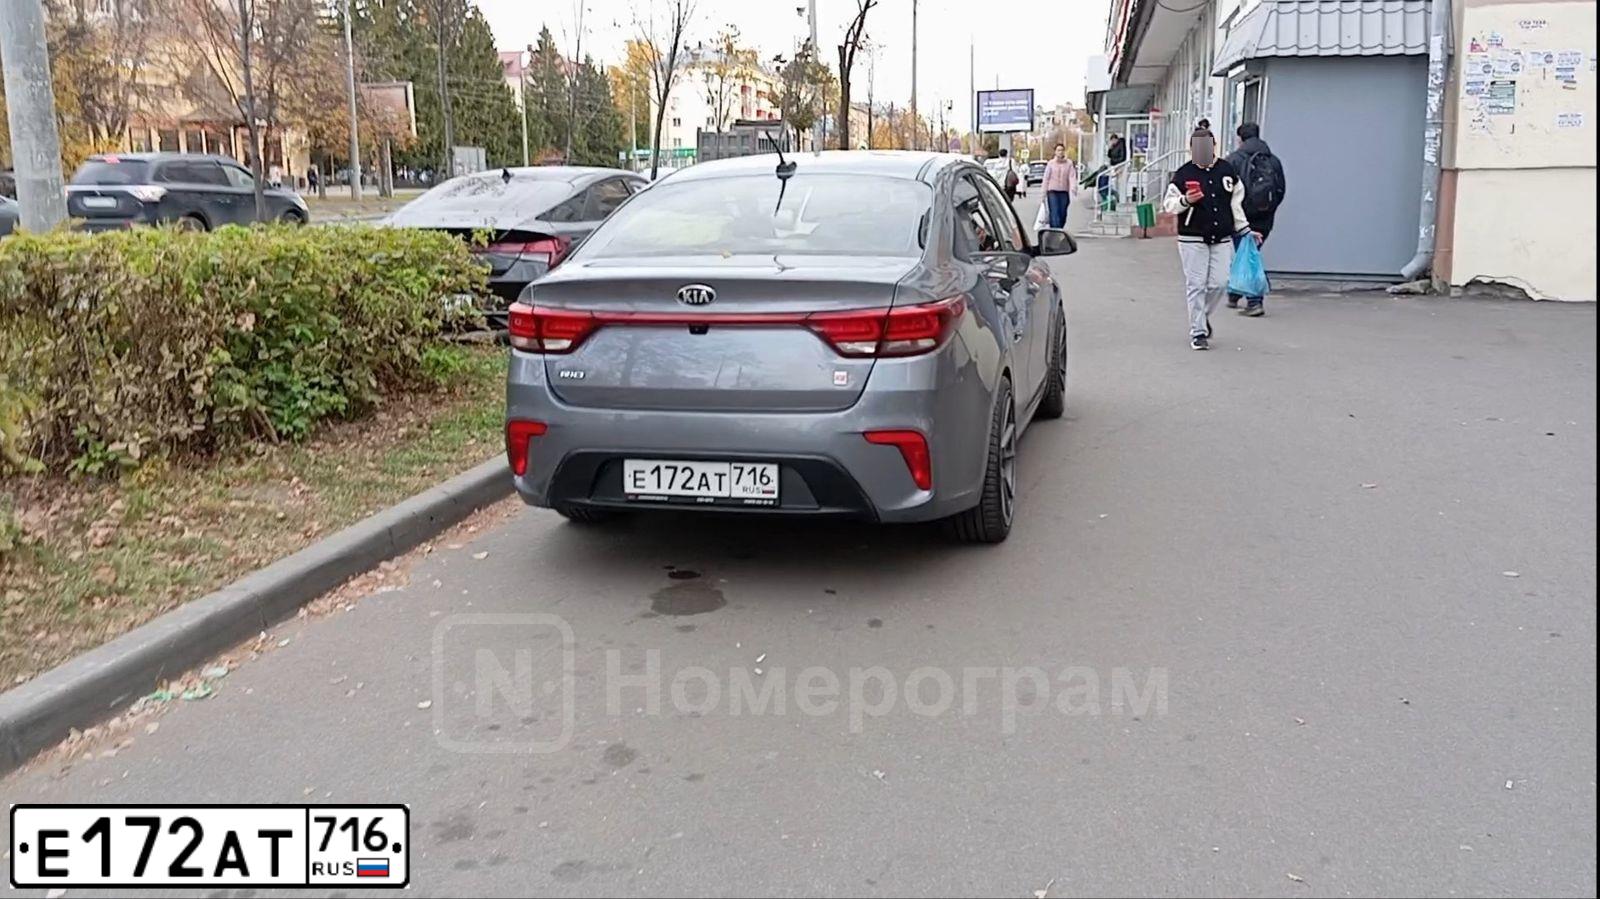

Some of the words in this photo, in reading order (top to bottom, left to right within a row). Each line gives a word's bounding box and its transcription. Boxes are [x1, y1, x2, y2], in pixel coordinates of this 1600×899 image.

[682, 289, 710, 304] KIA
[733, 466, 772, 486] 716
[742, 486, 761, 494] RUS
